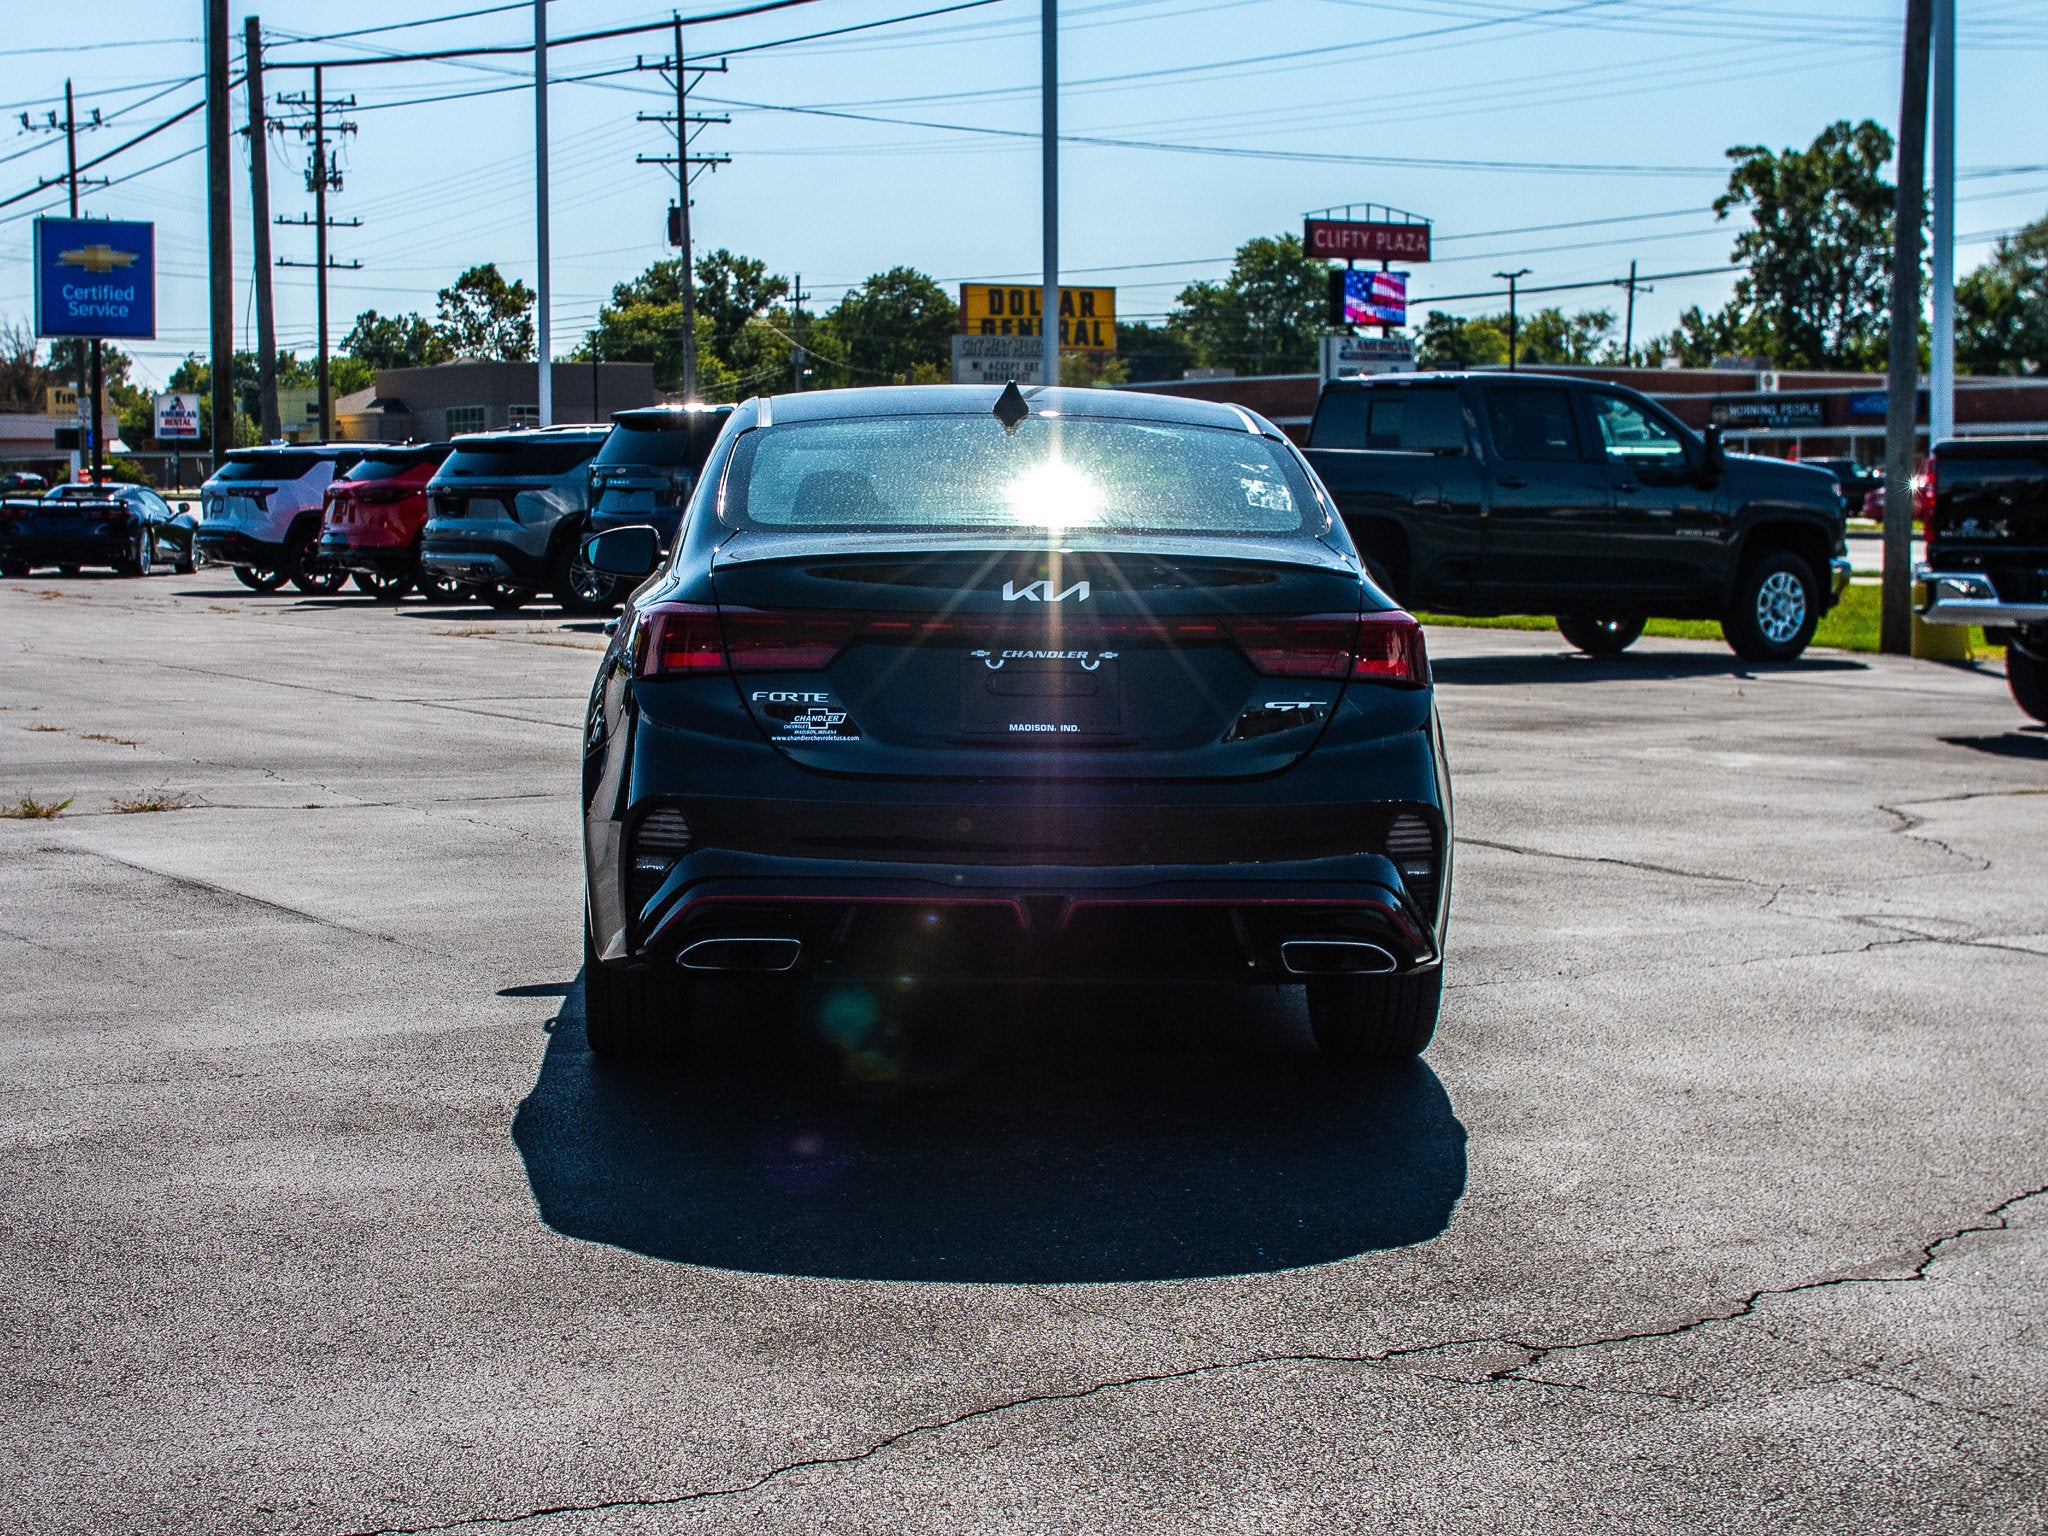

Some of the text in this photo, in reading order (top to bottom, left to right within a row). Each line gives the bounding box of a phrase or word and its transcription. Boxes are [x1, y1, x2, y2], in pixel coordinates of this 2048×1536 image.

[1314, 229, 1427, 252] CLIFTY PLAZA
[62, 284, 134, 300] Certified
[68, 301, 129, 317] Service
[988, 289, 1095, 317] DOLAR
[160, 410, 198, 418] AMERICAN
[165, 417, 191, 426] RENTAL
[1002, 580, 1090, 602] KIA
[1002, 650, 1088, 659] CHANDLER
[752, 692, 829, 702] FORTE
[1060, 724, 1081, 732] IND.
